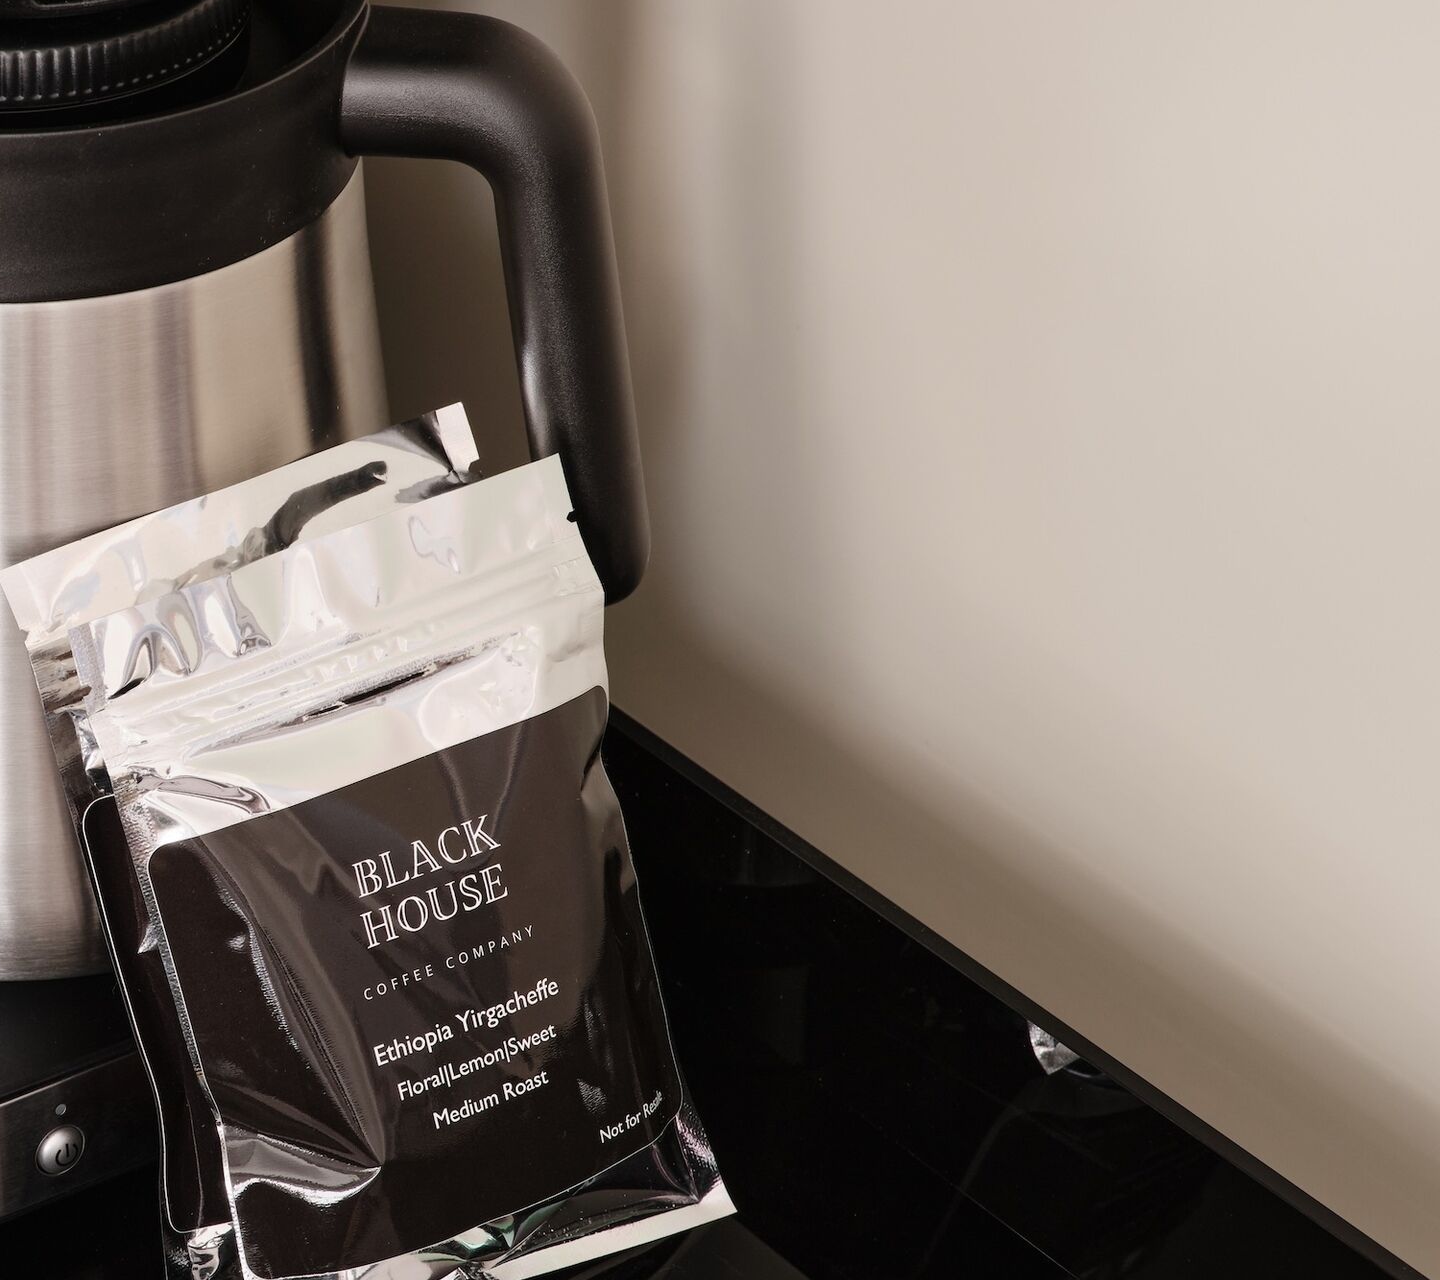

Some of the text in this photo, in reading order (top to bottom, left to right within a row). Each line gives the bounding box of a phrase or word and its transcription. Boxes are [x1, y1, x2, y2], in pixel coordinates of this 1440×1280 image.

[351, 814, 501, 899] BLACK
[360, 863, 509, 949] HOUSE
[363, 925, 535, 1001] COFFEE COMPANY
[372, 977, 560, 1066] Ethiopia Yirgacheffe
[396, 1024, 558, 1101] Floral|Lemon|Sweet
[432, 1070, 550, 1130] Medium Roast
[599, 1122, 625, 1144] Not
[625, 1111, 642, 1129] for
